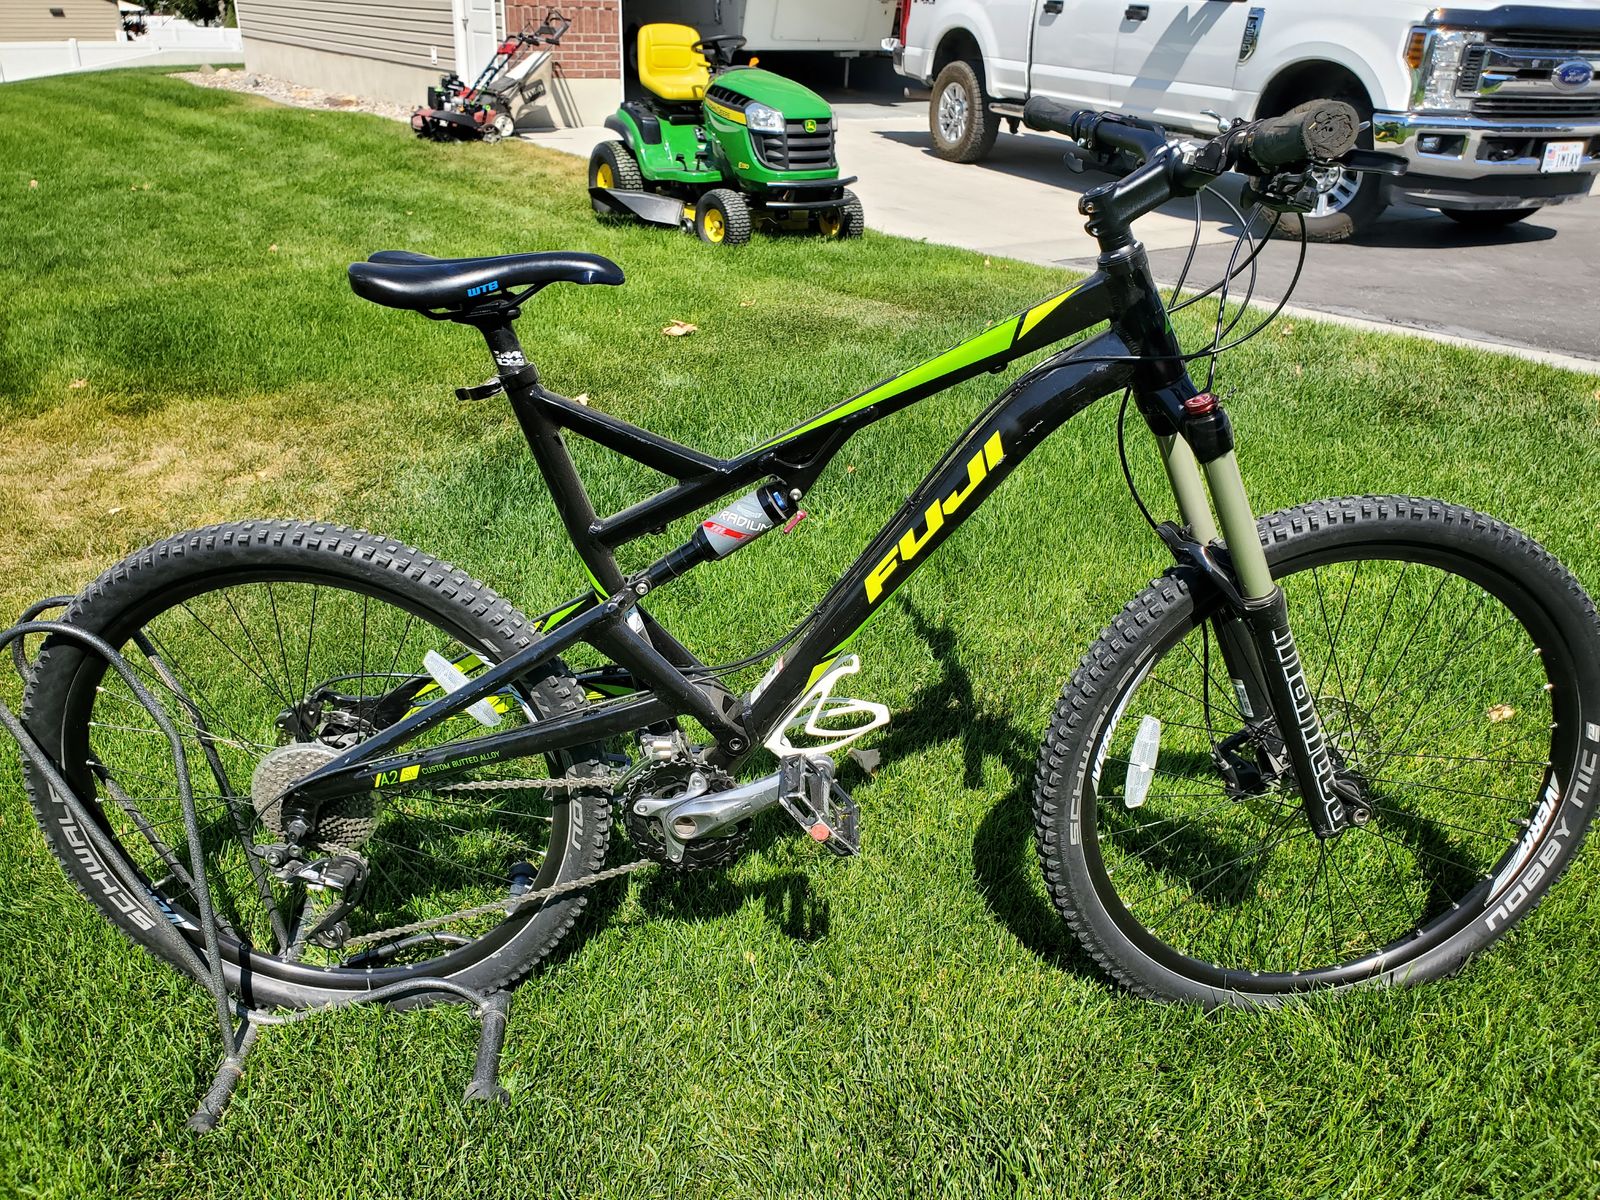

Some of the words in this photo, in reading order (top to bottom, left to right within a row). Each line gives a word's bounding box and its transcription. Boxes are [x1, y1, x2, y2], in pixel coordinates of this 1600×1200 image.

[466, 280, 499, 298] WTB
[719, 511, 774, 532] RADIUM
[864, 430, 1004, 604] FUJI
[421, 762, 451, 775] CUSTOM
[451, 756, 479, 768] BUTTED
[480, 751, 500, 761] ALLOY
[47, 783, 157, 932] SCHWAL
[1484, 816, 1571, 932] NOBBY
[1570, 749, 1598, 809] NIC
